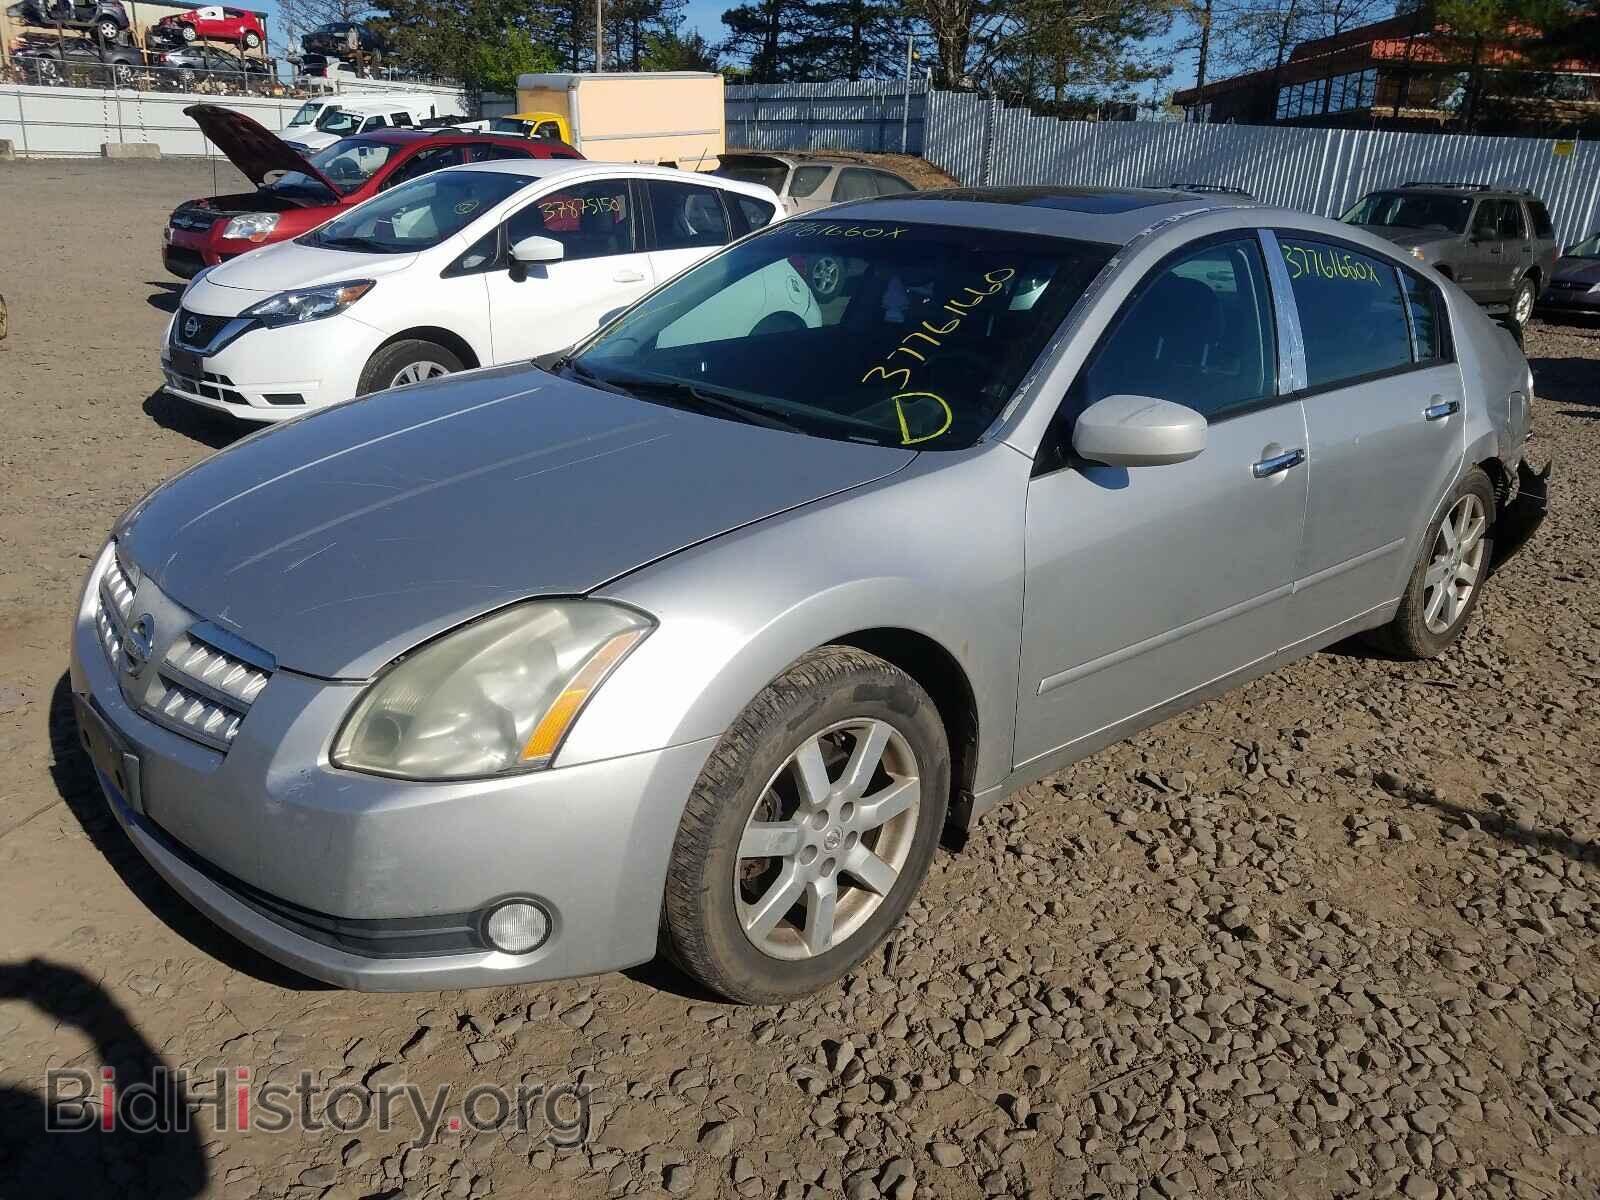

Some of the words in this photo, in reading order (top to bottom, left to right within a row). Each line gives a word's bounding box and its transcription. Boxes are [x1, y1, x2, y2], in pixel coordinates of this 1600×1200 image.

[537, 194, 621, 222] 37875150
[861, 268, 1016, 390] 37761660
[889, 391, 953, 445] D
